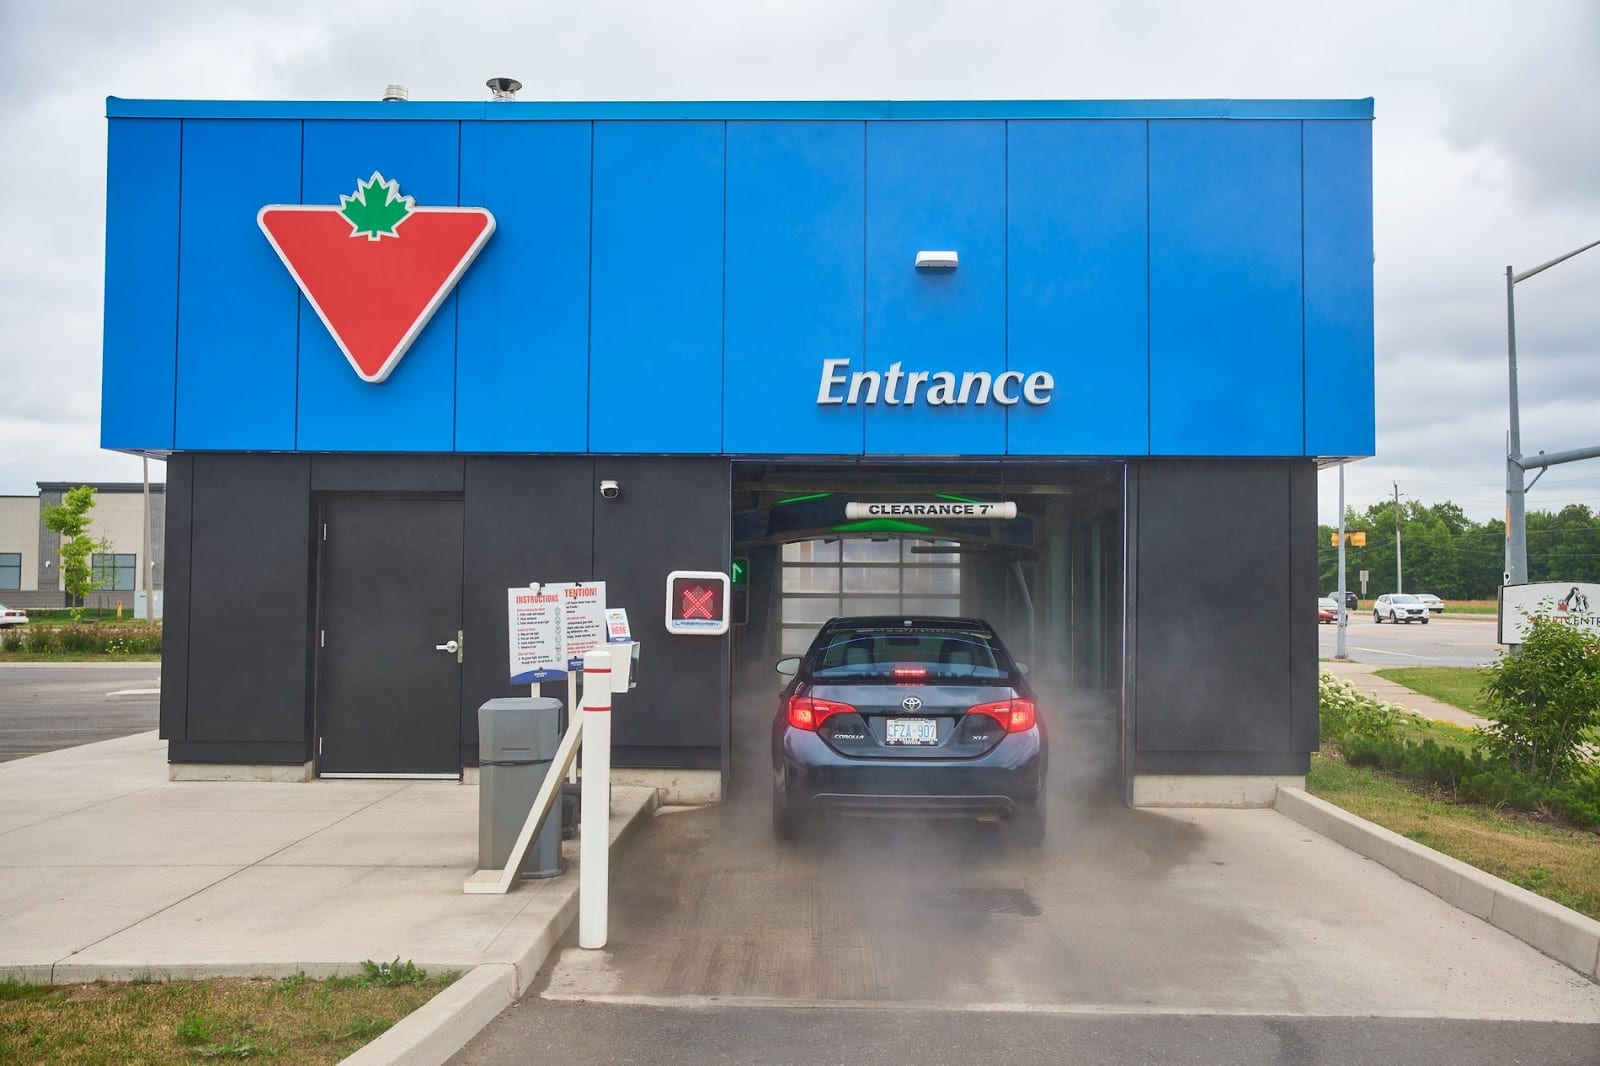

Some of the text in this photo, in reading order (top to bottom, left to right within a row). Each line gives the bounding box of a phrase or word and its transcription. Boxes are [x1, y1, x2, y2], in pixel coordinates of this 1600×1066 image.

[816, 357, 1055, 406] Entrance
[868, 504, 994, 515] CLEARANCE 7'
[564, 587, 598, 598] TENTION!
[516, 594, 559, 604] INSTRUCTIONS
[611, 626, 628, 635] HERE
[887, 724, 936, 738] CFZA 907
